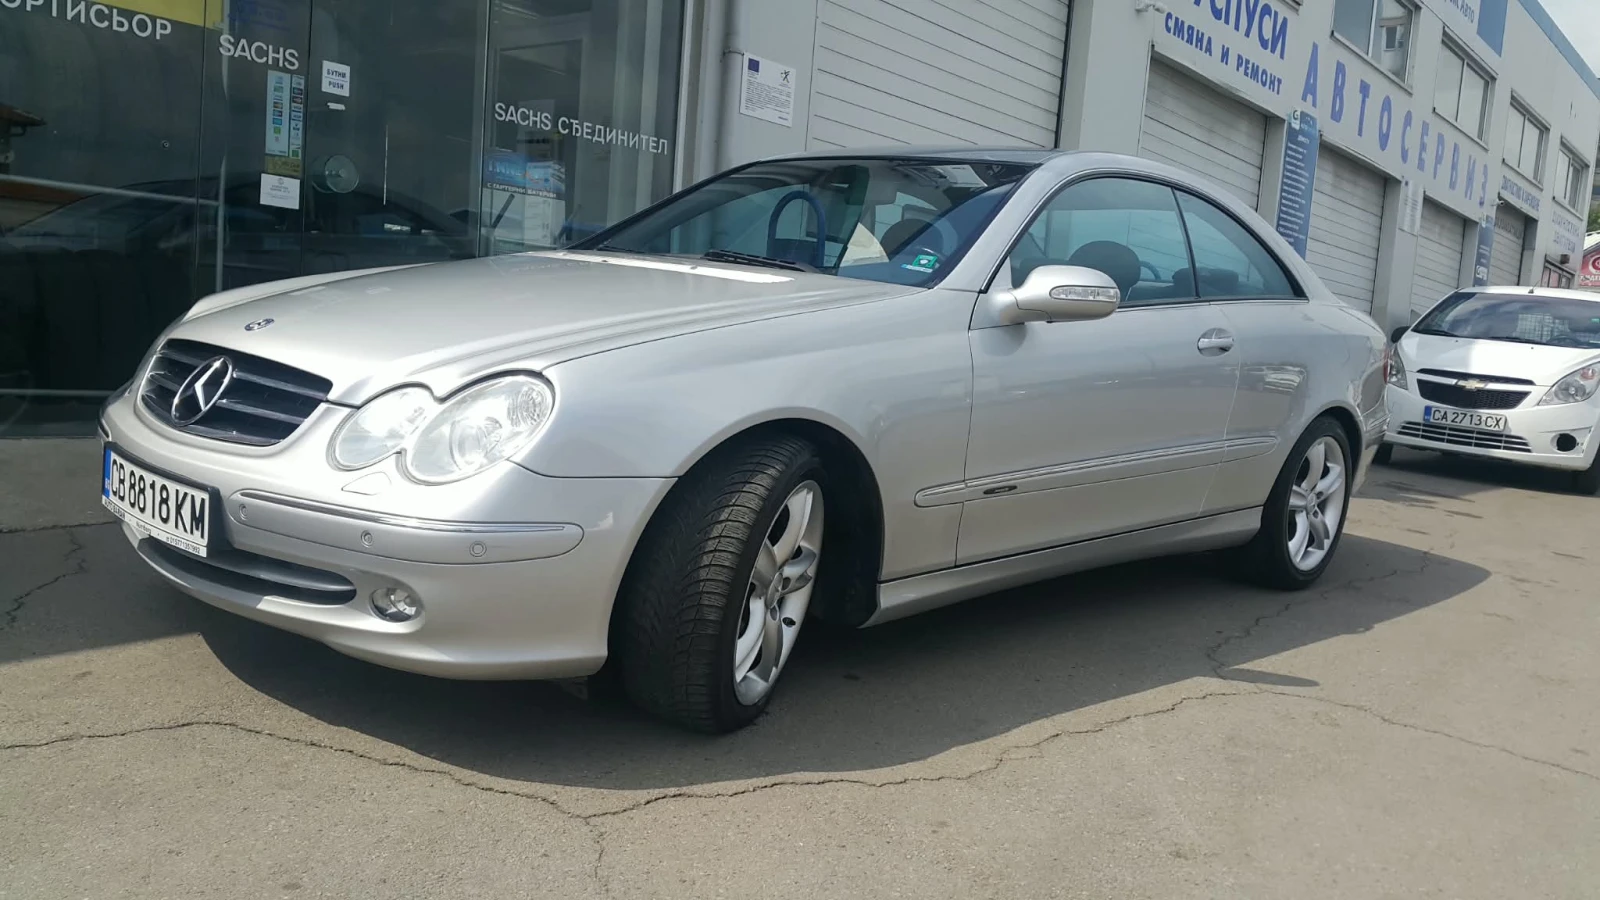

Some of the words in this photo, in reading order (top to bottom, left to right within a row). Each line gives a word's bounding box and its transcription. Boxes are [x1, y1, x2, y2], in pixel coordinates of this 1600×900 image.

[218, 34, 300, 70] SACHS
[1164, 11, 1213, 57] СМЯНА
[1220, 44, 1230, 66] И
[1235, 53, 1283, 95] РЕМОНТ
[326, 68, 347, 79] БУТНИ
[328, 79, 345, 91] PUSH
[494, 103, 551, 131] SACHS
[1301, 41, 1489, 208] АВТОСЕРВИЗ
[1432, 409, 1448, 422] CA
[1450, 411, 1483, 426] 2713
[1484, 415, 1503, 429] CX
[110, 458, 126, 502] CB
[128, 469, 170, 525] 8818
[174, 488, 206, 540] KM
